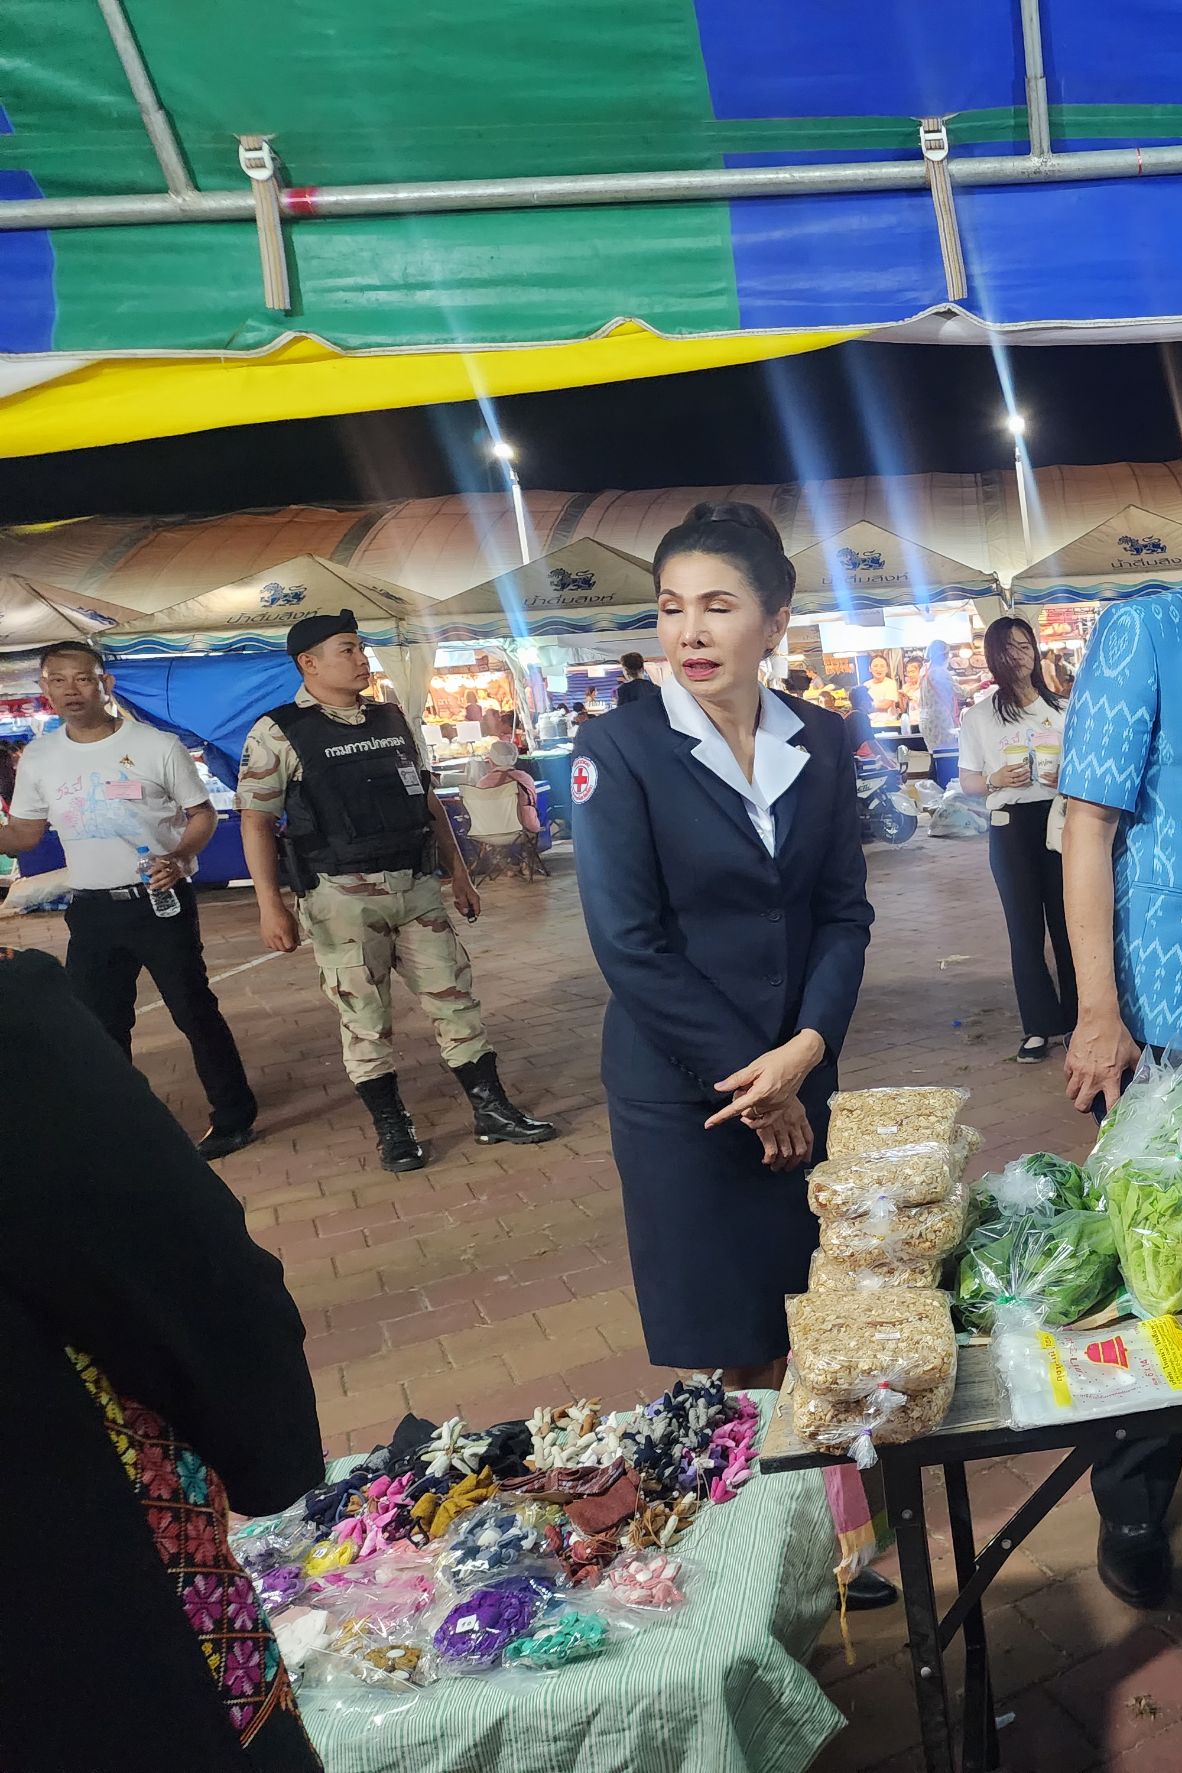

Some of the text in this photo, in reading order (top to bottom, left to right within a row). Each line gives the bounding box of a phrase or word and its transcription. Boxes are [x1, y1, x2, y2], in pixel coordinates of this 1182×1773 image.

[324, 735, 406, 758] กรมการปกครอง
